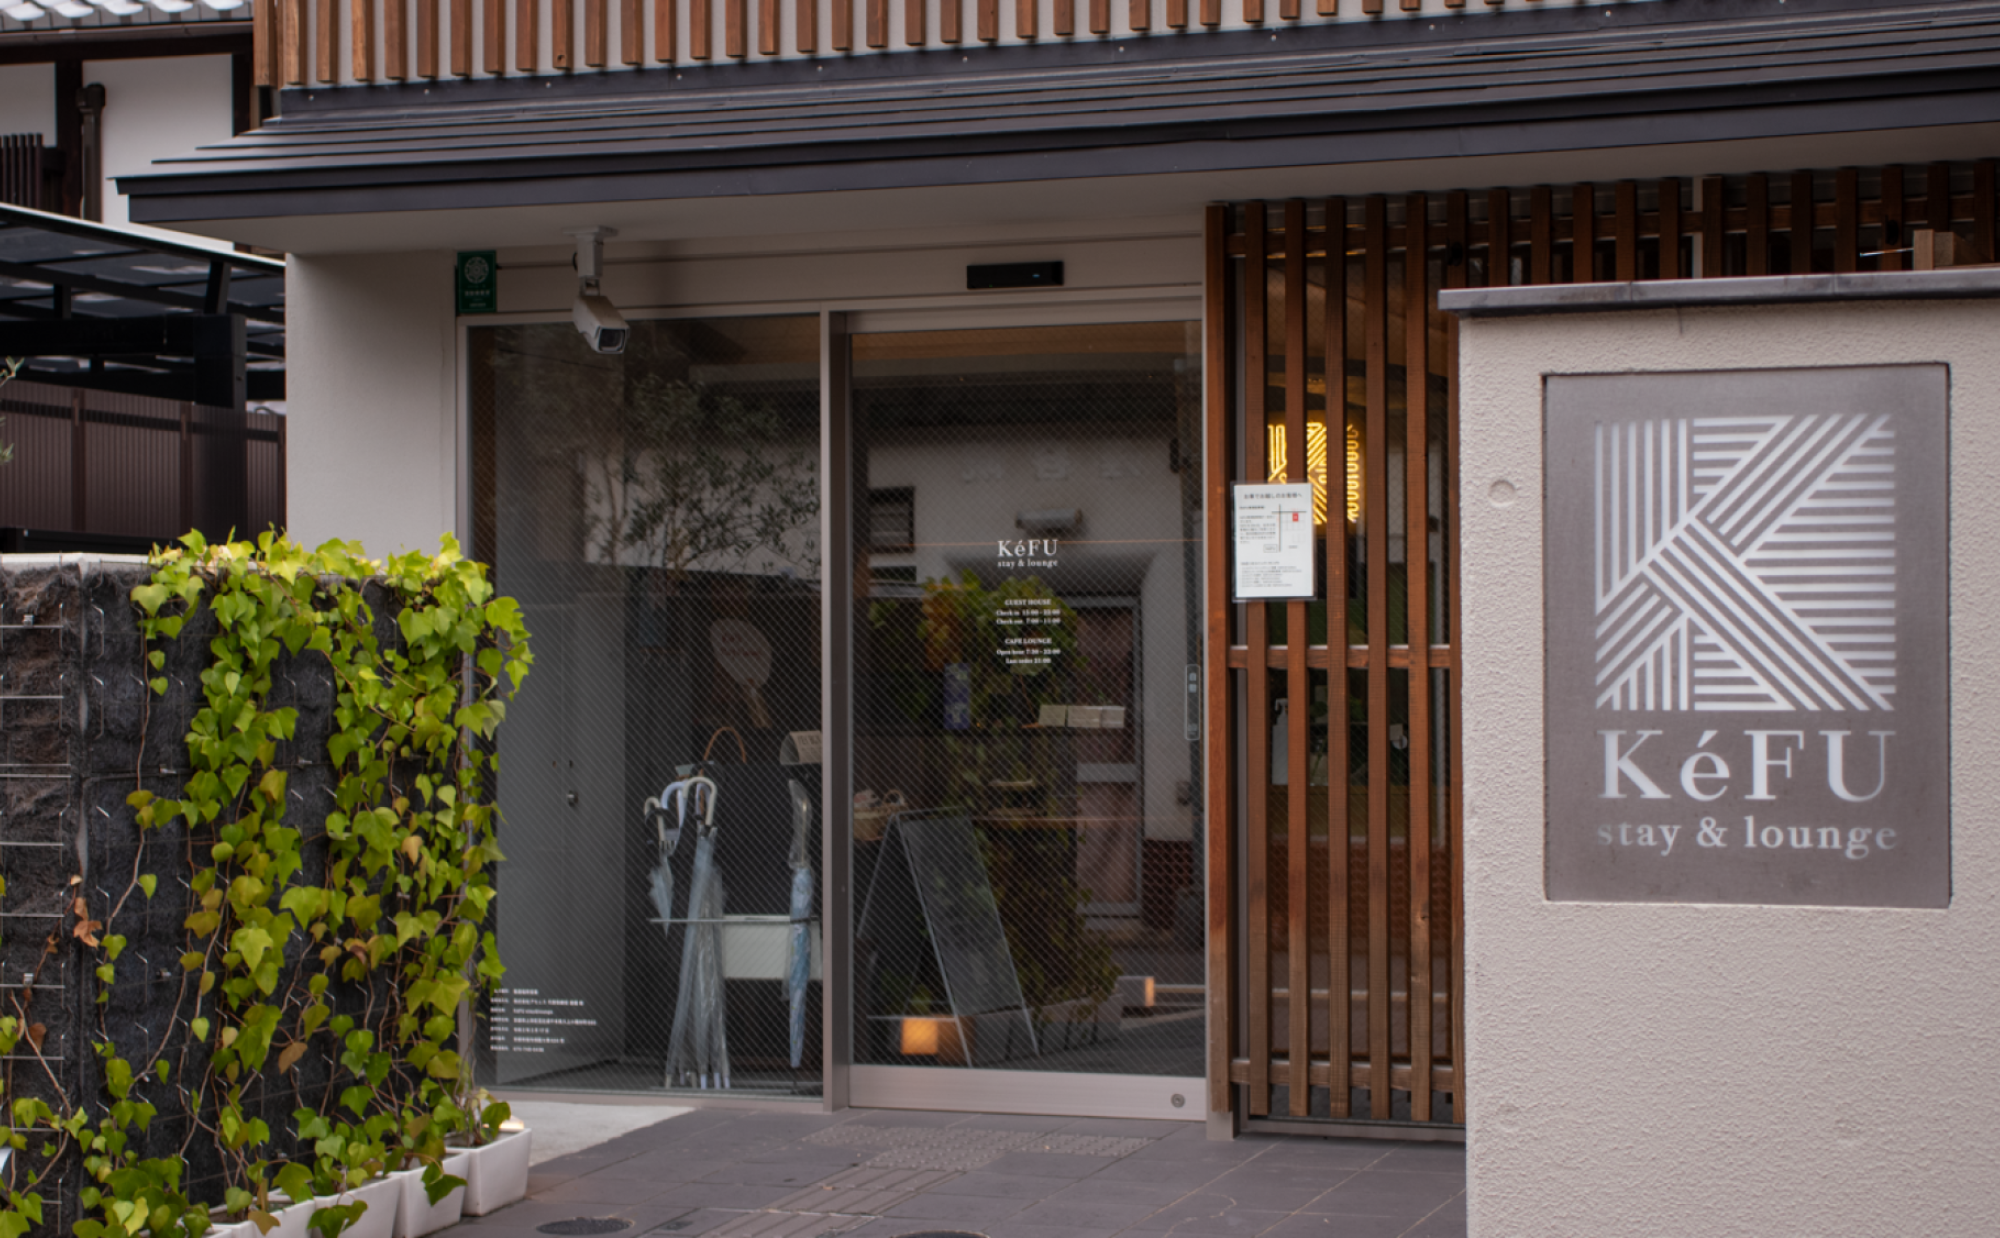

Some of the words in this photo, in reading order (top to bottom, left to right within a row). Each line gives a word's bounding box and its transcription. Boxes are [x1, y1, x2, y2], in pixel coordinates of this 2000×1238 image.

[997, 539, 1059, 557] KéFU
[997, 561, 1015, 569] stay
[1018, 558, 1025, 567] &
[1027, 559, 1058, 569] lounge
[1597, 729, 1897, 802] KéFU
[1597, 822, 1682, 856] stay
[1696, 816, 1729, 848] &
[1743, 815, 1898, 860] lounge
